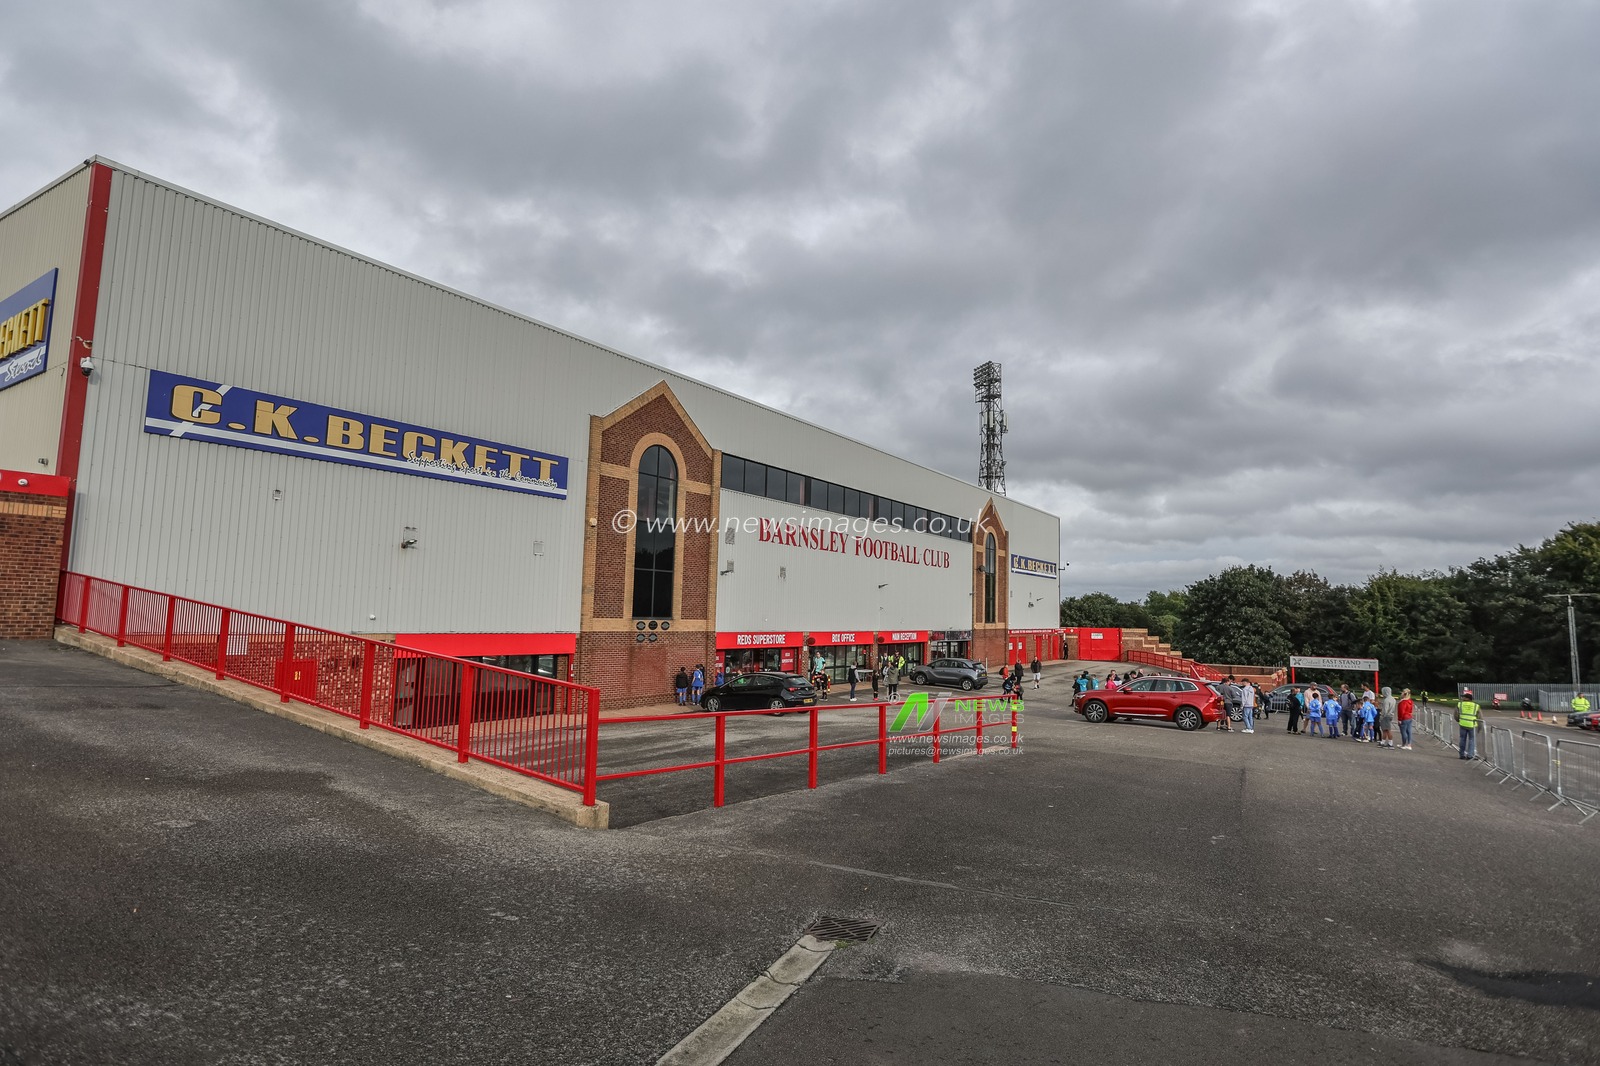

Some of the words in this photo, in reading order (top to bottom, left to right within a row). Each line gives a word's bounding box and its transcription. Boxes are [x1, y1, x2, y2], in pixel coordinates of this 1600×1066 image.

[407, 451, 456, 473] Supporting
[458, 461, 483, 475] Sport
[486, 466, 496, 477] in
[500, 468, 512, 480] the
[514, 470, 558, 490] Community
[758, 517, 849, 554] BARNSLEY
[855, 536, 920, 565] FOOTBALL
[923, 548, 950, 569] CLUB
[737, 634, 752, 645] REDS
[753, 634, 786, 645] SUPERSTORE
[831, 633, 841, 643] BOX
[841, 633, 856, 643] OFFICE
[900, 632, 918, 641] RECEPTION
